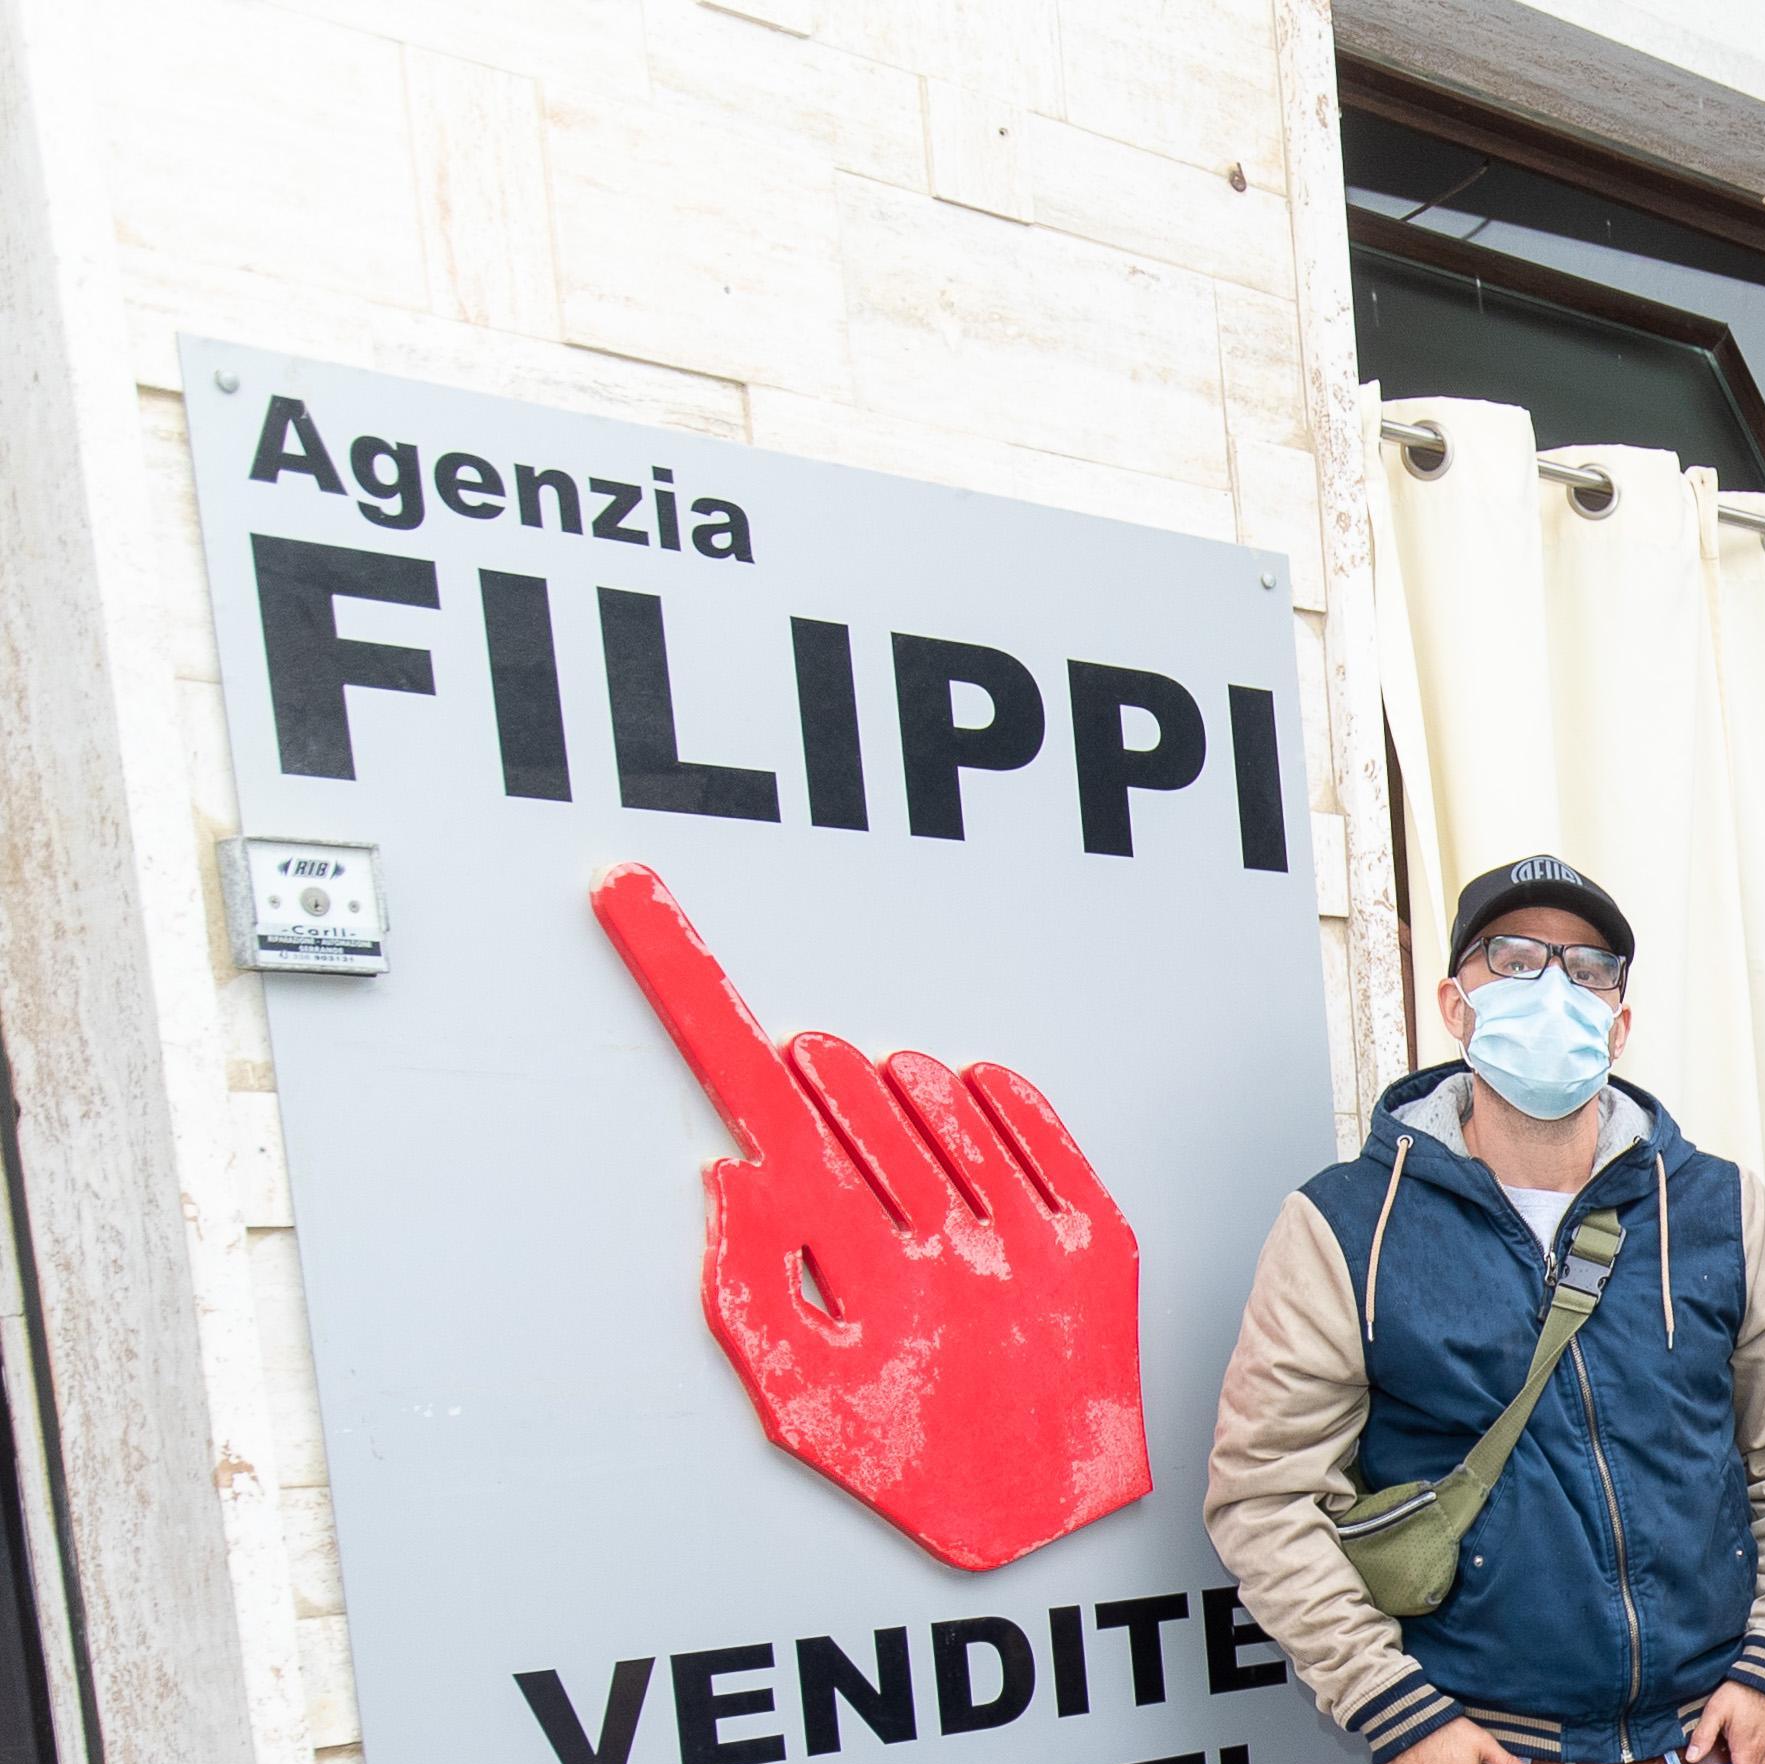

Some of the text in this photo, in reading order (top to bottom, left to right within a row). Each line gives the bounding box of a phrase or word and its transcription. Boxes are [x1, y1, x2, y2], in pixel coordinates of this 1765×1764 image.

[248, 395, 756, 565] Agenzia
[250, 533, 1290, 874] FILIPPI
[293, 860, 329, 878] RIB
